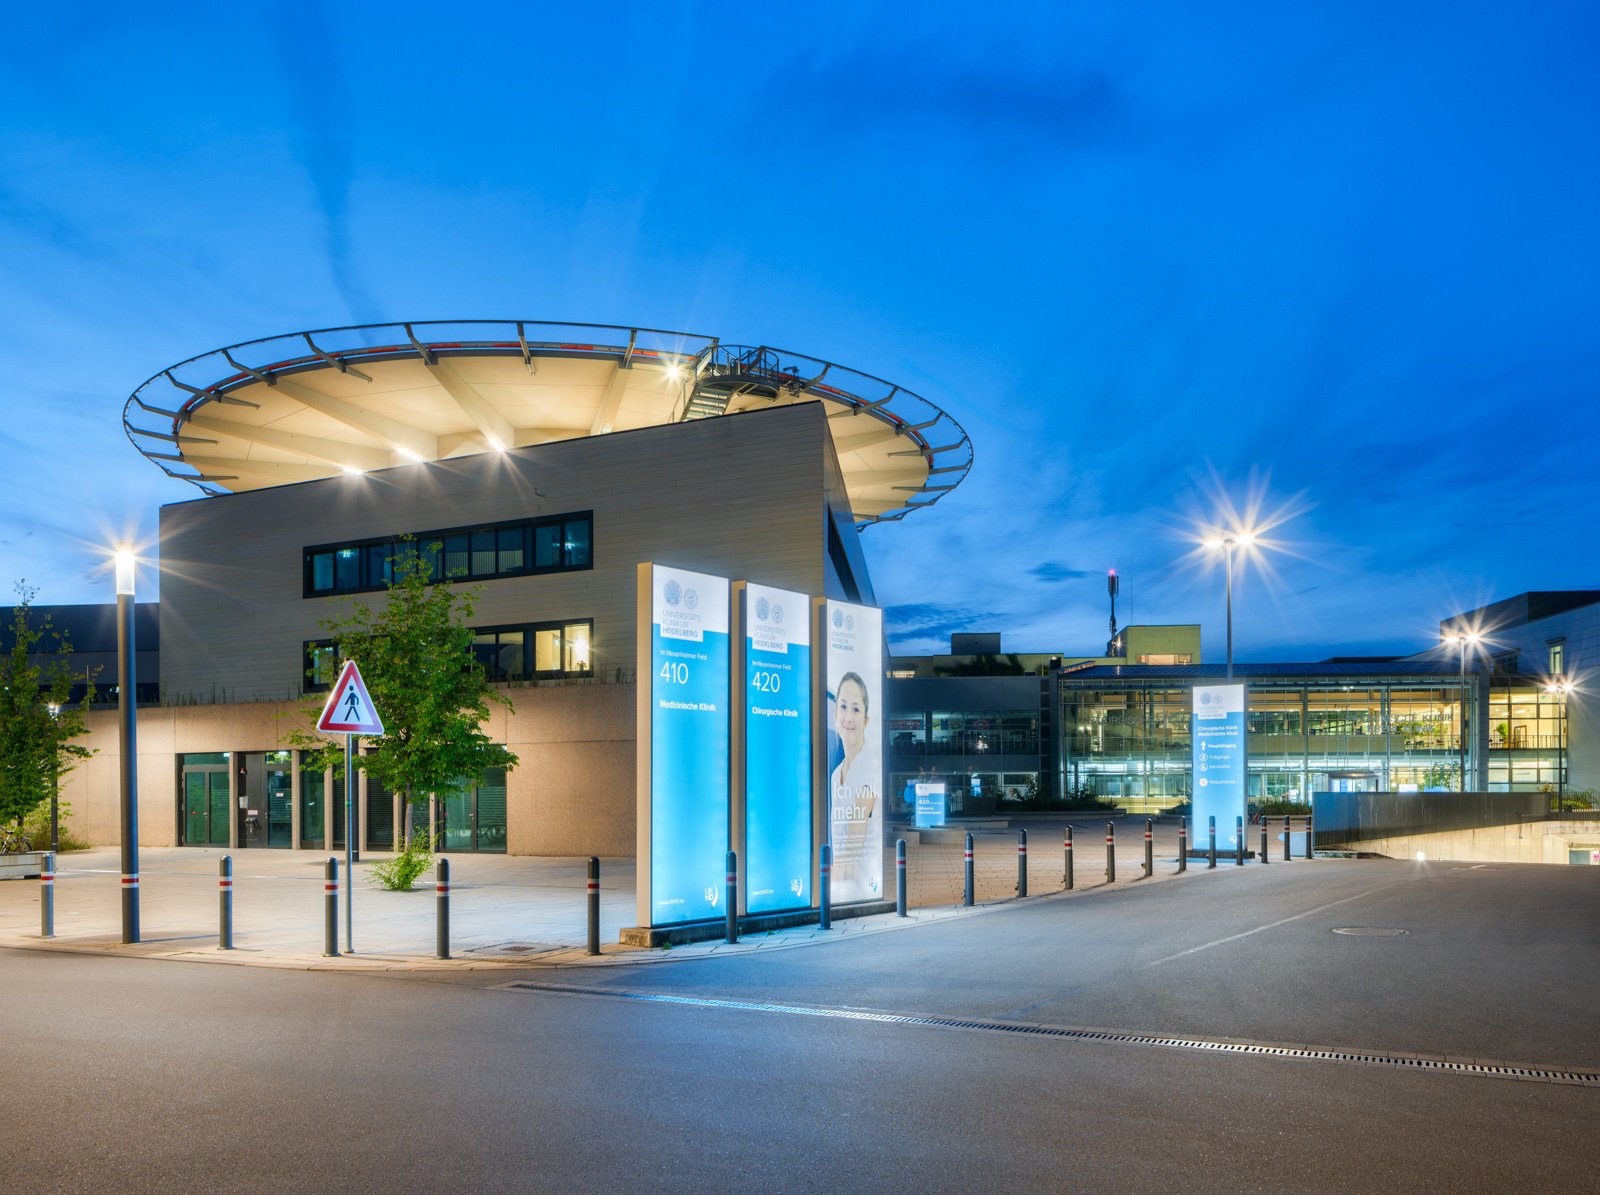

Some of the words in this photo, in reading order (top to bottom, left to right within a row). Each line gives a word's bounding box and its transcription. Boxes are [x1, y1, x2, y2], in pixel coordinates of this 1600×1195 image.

[662, 627, 698, 638] HEIDELBERG
[660, 661, 689, 684] 410
[752, 671, 781, 693] 420
[660, 699, 698, 711] Medizinische
[699, 703, 716, 712] Klinik
[752, 706, 783, 717] Chirurgische
[783, 709, 799, 718] Klinik
[1422, 713, 1454, 722] KLINIK
[833, 781, 852, 799] Ich
[833, 802, 866, 820] mehr
